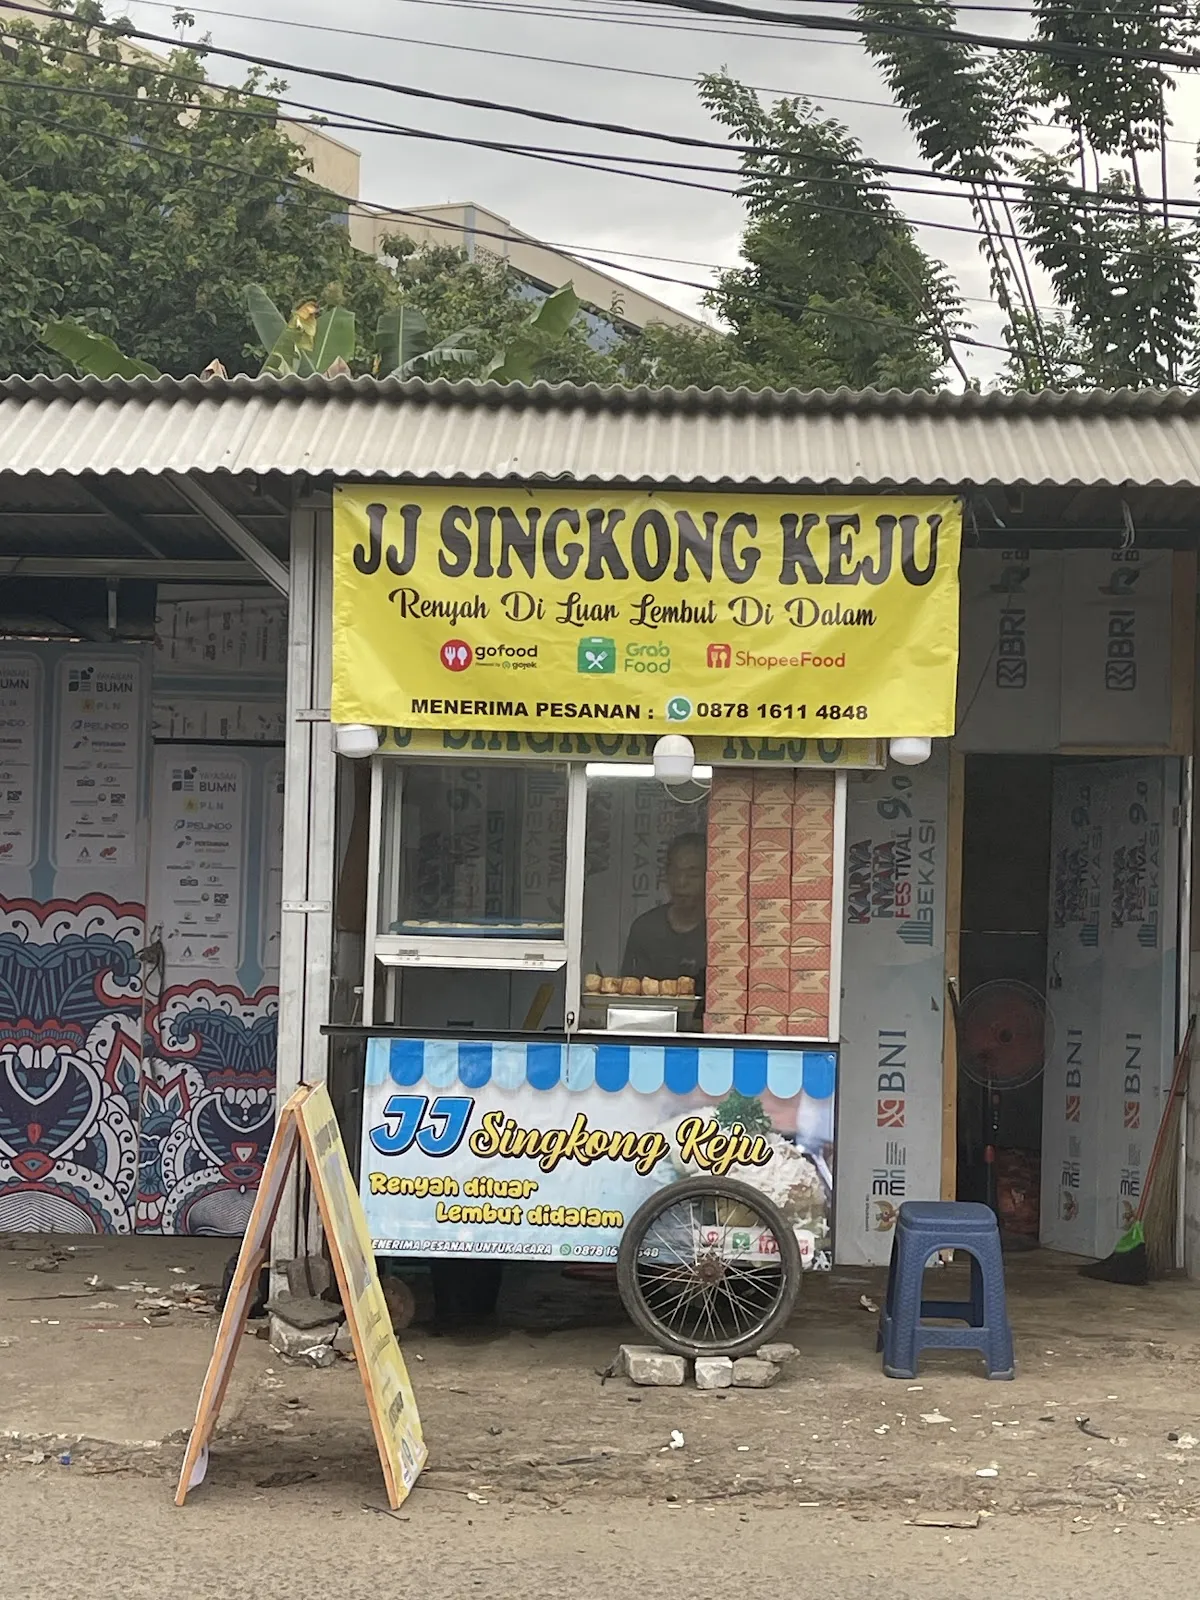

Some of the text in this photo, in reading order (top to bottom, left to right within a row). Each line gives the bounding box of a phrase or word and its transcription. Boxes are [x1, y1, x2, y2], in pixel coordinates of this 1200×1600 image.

[353, 503, 942, 587] JJ SINGKONG KEJU
[388, 587, 877, 629] Renyah Di Luar Lembut Di Dalam
[475, 644, 538, 660] gofood
[626, 641, 671, 657] Grab
[998, 609, 1026, 656] BRI
[1107, 610, 1135, 658] BRI
[624, 659, 671, 674] Food
[736, 651, 846, 670] ShopeeFood
[96, 682, 133, 692] BUMN
[411, 699, 529, 718] MENERIMA
[536, 702, 640, 720] PESANAN
[696, 702, 749, 719] 0878
[757, 703, 807, 720] 1611
[815, 704, 868, 721] 4848
[199, 781, 236, 792] BUMN
[847, 839, 872, 924] KARYA
[871, 840, 895, 918] NYATA
[895, 826, 912, 919] FESTIVAL
[917, 819, 936, 922] BEKASI
[1089, 825, 1102, 925] BEKASI
[1148, 822, 1160, 925] BEKASI
[878, 1029, 907, 1093] BNI
[1066, 1029, 1083, 1088] BNI
[1124, 1033, 1142, 1094] BNI
[369, 1094, 474, 1158] JJ
[469, 1110, 670, 1176] Singkong
[676, 1116, 775, 1177] Keju
[369, 1172, 539, 1200] Renyah diluar
[435, 1202, 623, 1228] Lembut didalam
[371, 1240, 421, 1251] ENERIMA
[421, 1240, 471, 1252] PESANAN
[471, 1242, 513, 1254] UNTUK
[513, 1243, 552, 1255] ACARA
[574, 1244, 603, 1256] 0878
